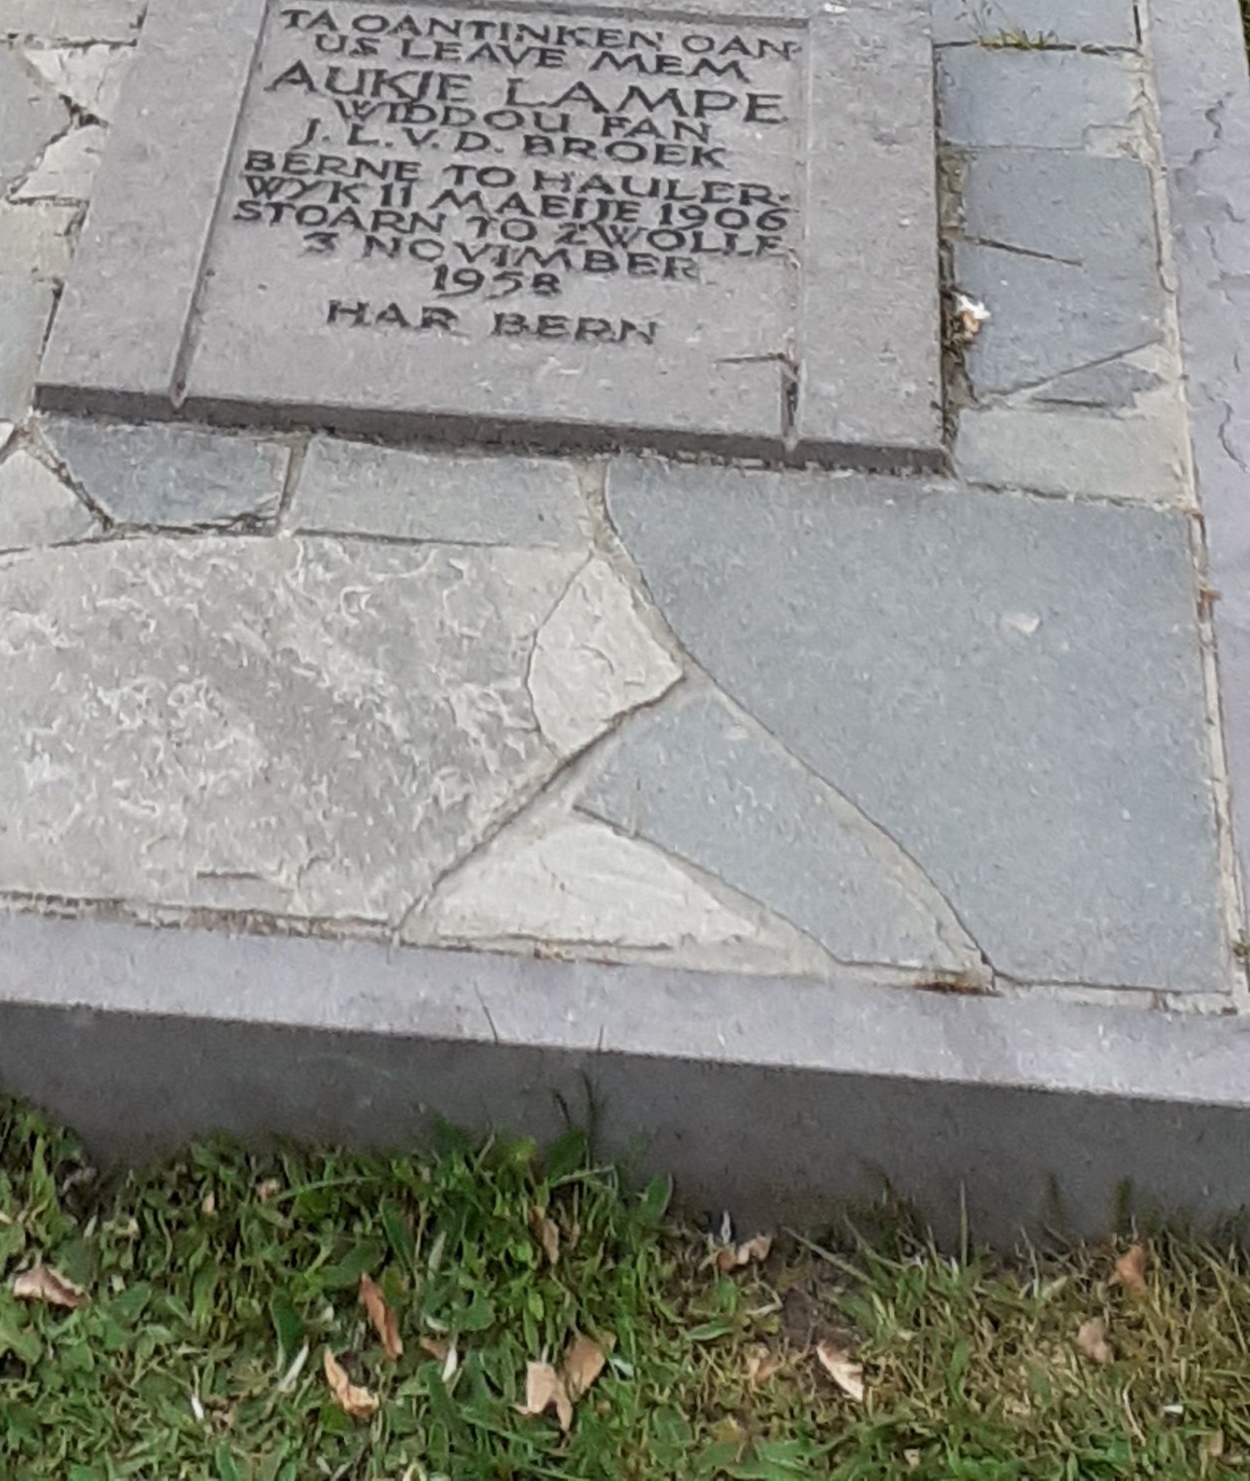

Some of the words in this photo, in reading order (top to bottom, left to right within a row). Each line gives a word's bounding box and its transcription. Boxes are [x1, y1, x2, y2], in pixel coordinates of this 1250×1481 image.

[281, 9, 338, 32] TA
[351, 14, 664, 51] OANTINKEN
[682, 35, 795, 61] OAN
[315, 33, 381, 57] US
[400, 38, 566, 69] LEAVE
[589, 50, 751, 84] MEM
[264, 59, 472, 103] AUKJE
[506, 77, 789, 125] LAMPE
[333, 98, 570, 134] WIDDOU
[601, 115, 712, 144] FAN
[244, 149, 423, 182] BERNE
[442, 163, 517, 188] TO
[523, 135, 730, 171] BROEK
[244, 175, 362, 205] WYK
[658, 202, 790, 232] 1906
[232, 200, 447, 235] STOARN
[466, 215, 538, 243] TO
[555, 219, 784, 257] ZWOLLE
[362, 235, 700, 279] NOVIMBER
[432, 263, 562, 299] 1958
[327, 299, 458, 332] HAR
[491, 312, 657, 345] BERN
